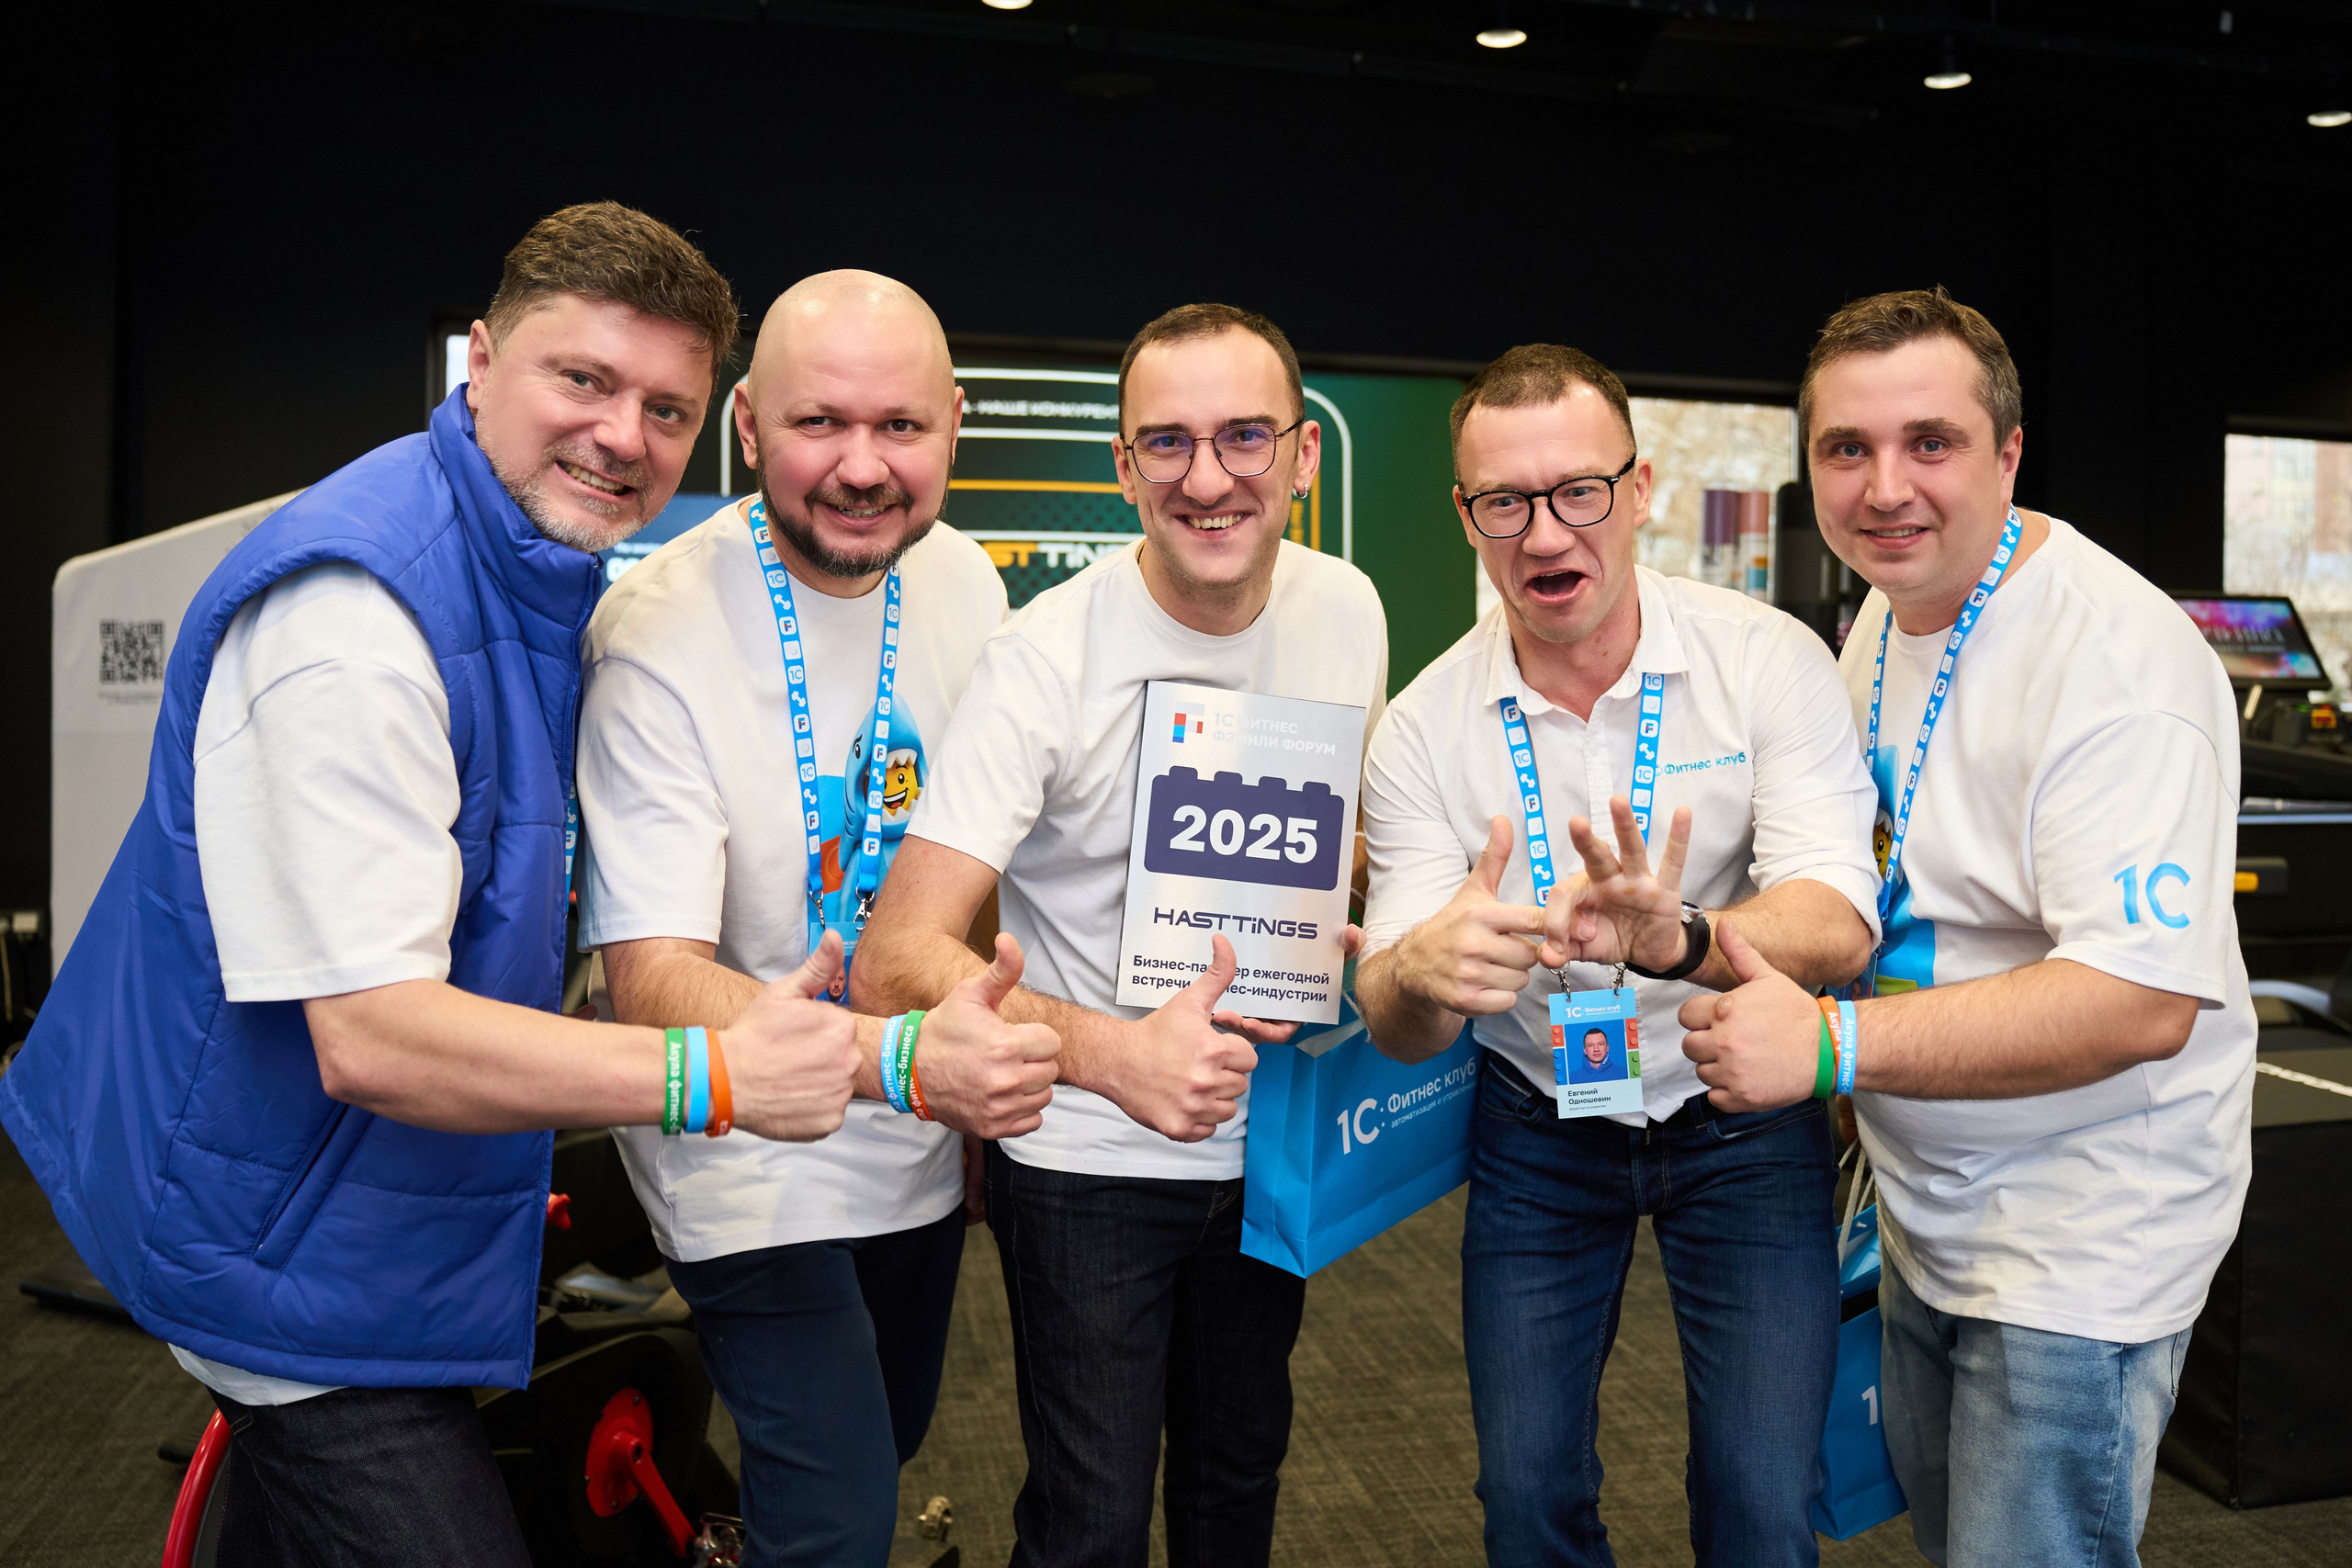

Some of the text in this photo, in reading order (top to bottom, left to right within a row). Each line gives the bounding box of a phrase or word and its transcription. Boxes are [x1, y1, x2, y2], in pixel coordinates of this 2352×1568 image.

[1282, 739, 1336, 755] ФОРУМ
[1715, 752, 1747, 767] клуб
[1169, 804, 1318, 863] 2025
[2114, 863, 2191, 930] 1С
[1132, 975, 1191, 989] встречи
[1133, 954, 1330, 985] Бизнес-паер ежегодной
[1843, 1018, 1855, 1049] Акула
[668, 1042, 682, 1077] Акула
[882, 1020, 898, 1100] фитнес-бизнеса
[1387, 1077, 1442, 1113] Фитнес
[1444, 1056, 1476, 1088] клуб
[1567, 1088, 1599, 1097] Евгений
[1391, 1100, 1437, 1128] автоматизация
[1861, 1385, 1878, 1425] 1
